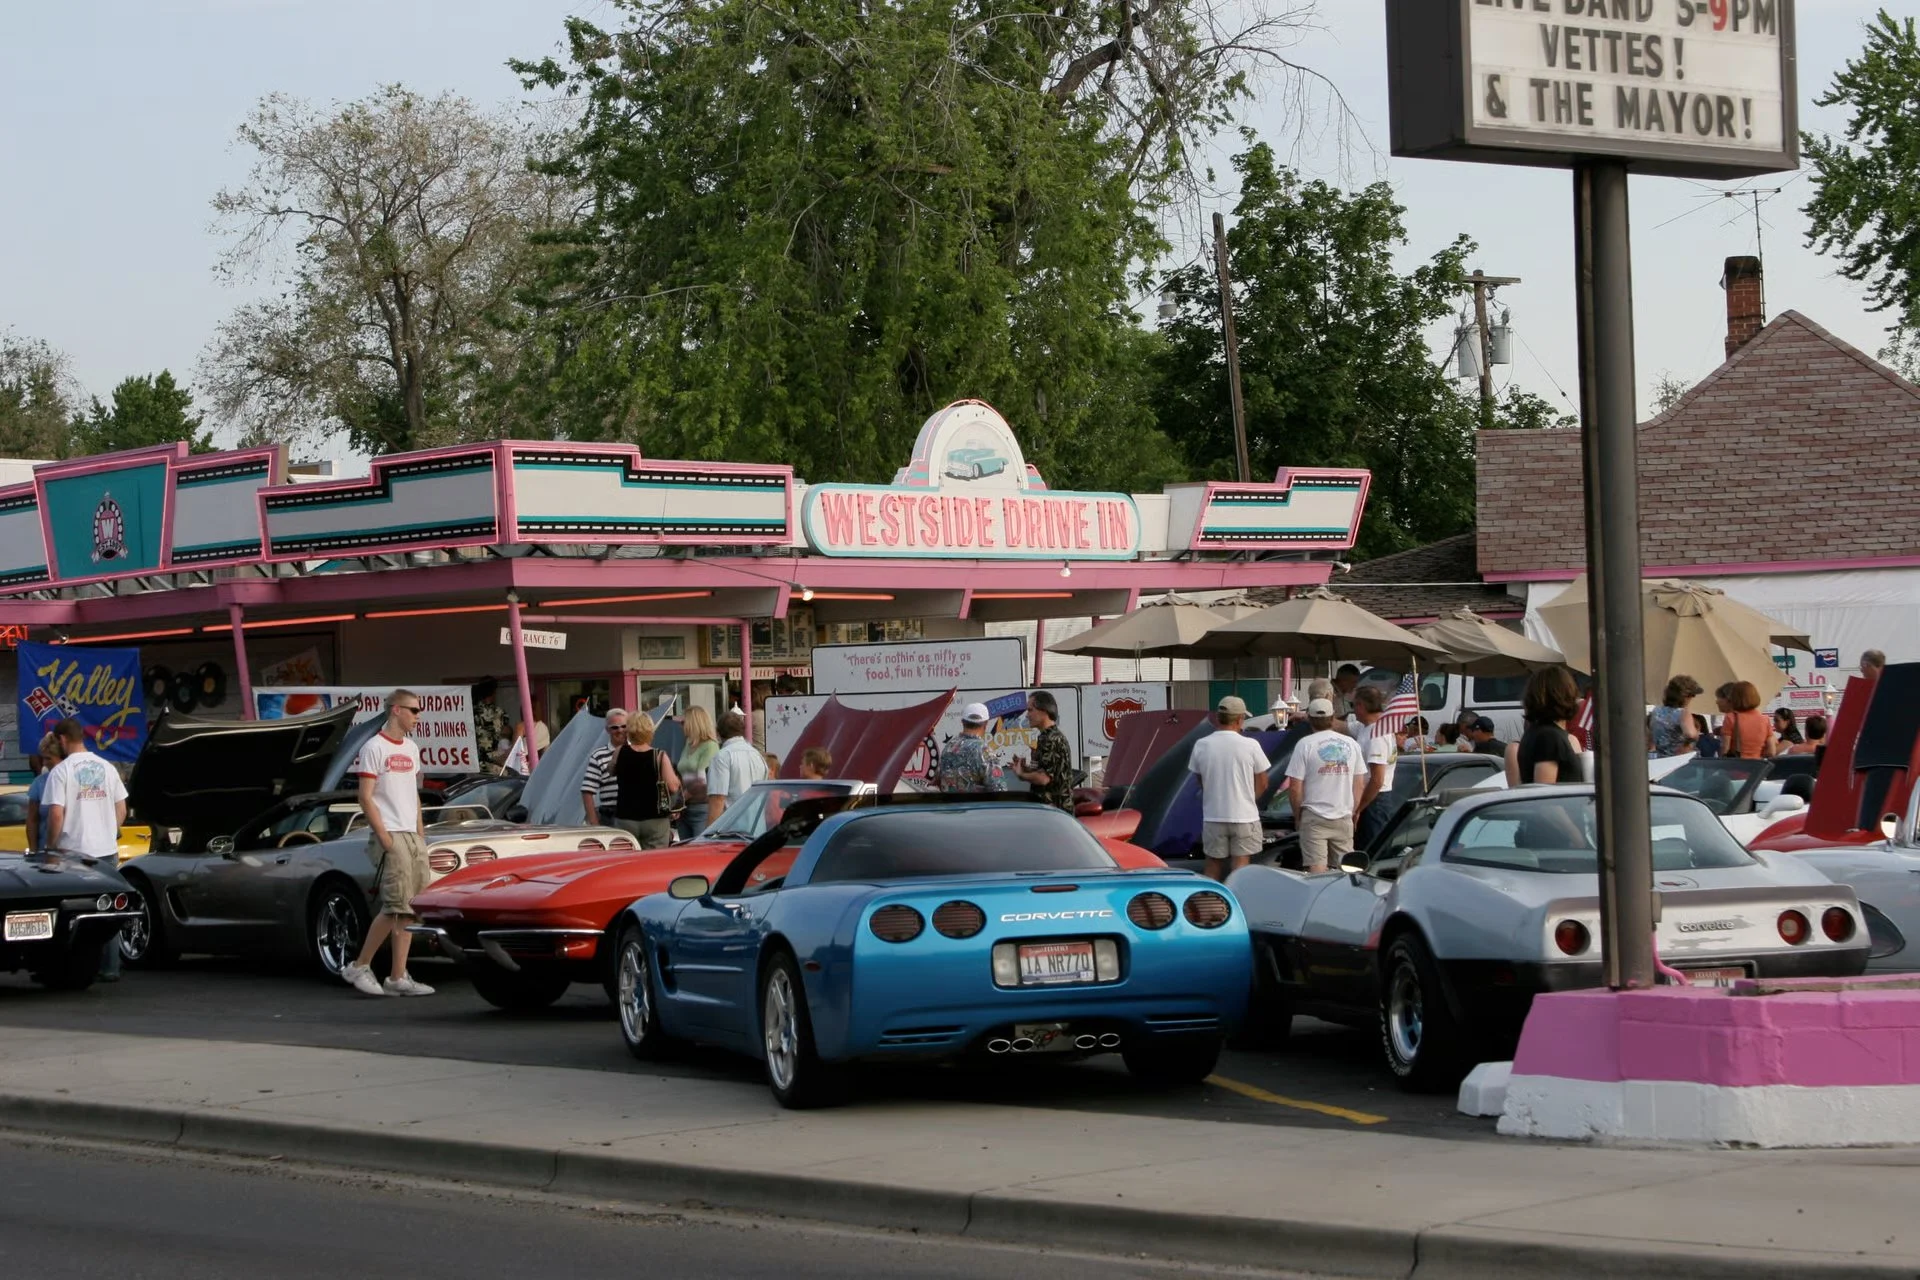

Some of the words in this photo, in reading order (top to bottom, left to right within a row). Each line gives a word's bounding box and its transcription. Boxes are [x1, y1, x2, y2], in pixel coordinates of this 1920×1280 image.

[1540, 24, 1684, 80] VETTES!
[1486, 73, 1507, 119] &
[1529, 78, 1594, 126] THE
[1616, 85, 1753, 140] MAYOR!
[820, 492, 994, 547] WESTSIDE
[1003, 497, 1092, 549] DRIVE
[1096, 501, 1129, 550] IN
[506, 631, 547, 645] CRANCE
[918, 654, 930, 663] as
[934, 649, 956, 664] nifty
[960, 653, 971, 661] as
[865, 667, 894, 681] food,
[895, 665, 913, 679] fun
[37, 658, 141, 751] Valley
[989, 696, 1022, 714] IDAHO
[416, 722, 431, 737] RIB
[434, 722, 468, 737] DINNER
[419, 747, 470, 765] CLOSE
[1001, 909, 1114, 922] CORVETTE
[1680, 920, 1735, 932] corvette
